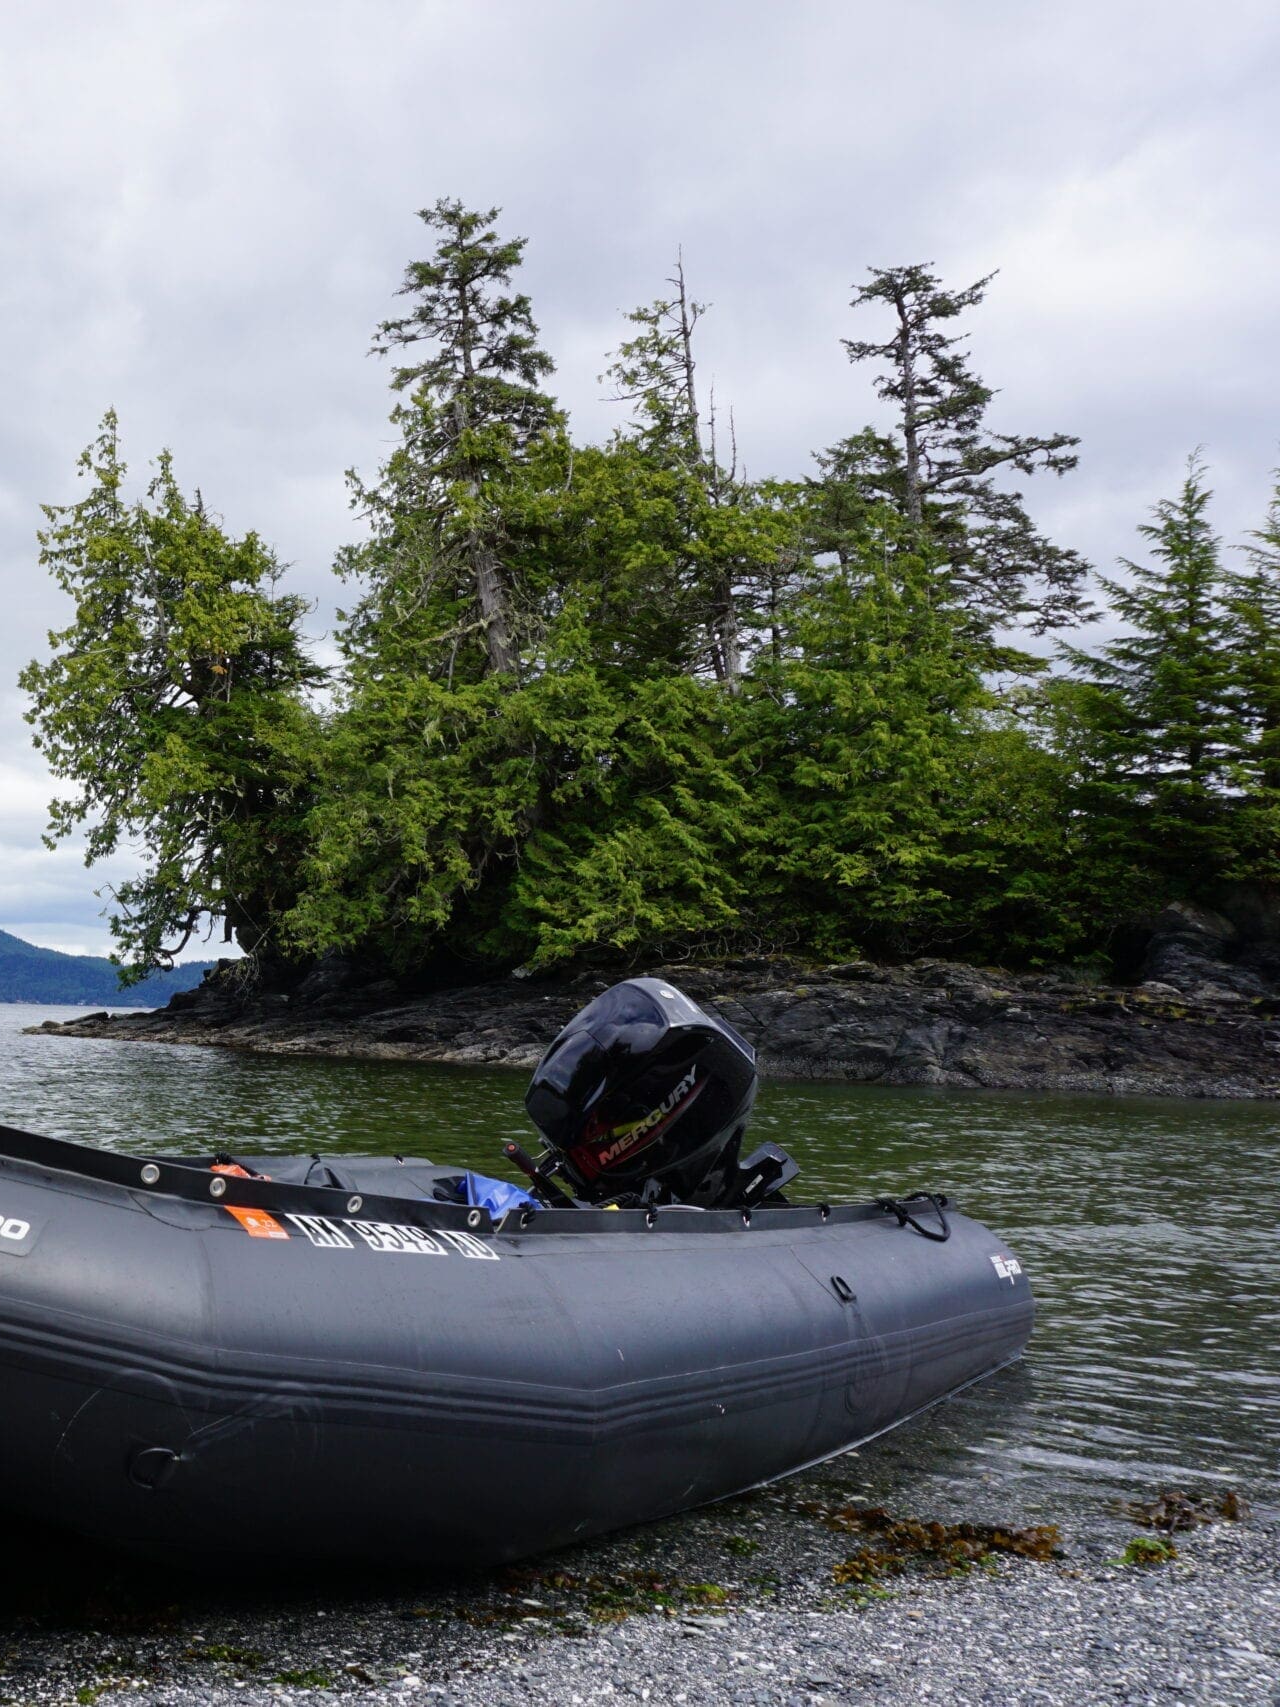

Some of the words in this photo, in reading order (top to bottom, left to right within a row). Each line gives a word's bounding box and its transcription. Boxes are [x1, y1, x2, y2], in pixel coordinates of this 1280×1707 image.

[598, 1064, 697, 1166] MERCURY
[292, 1214, 351, 1247] AK
[349, 1220, 440, 1253] 9549
